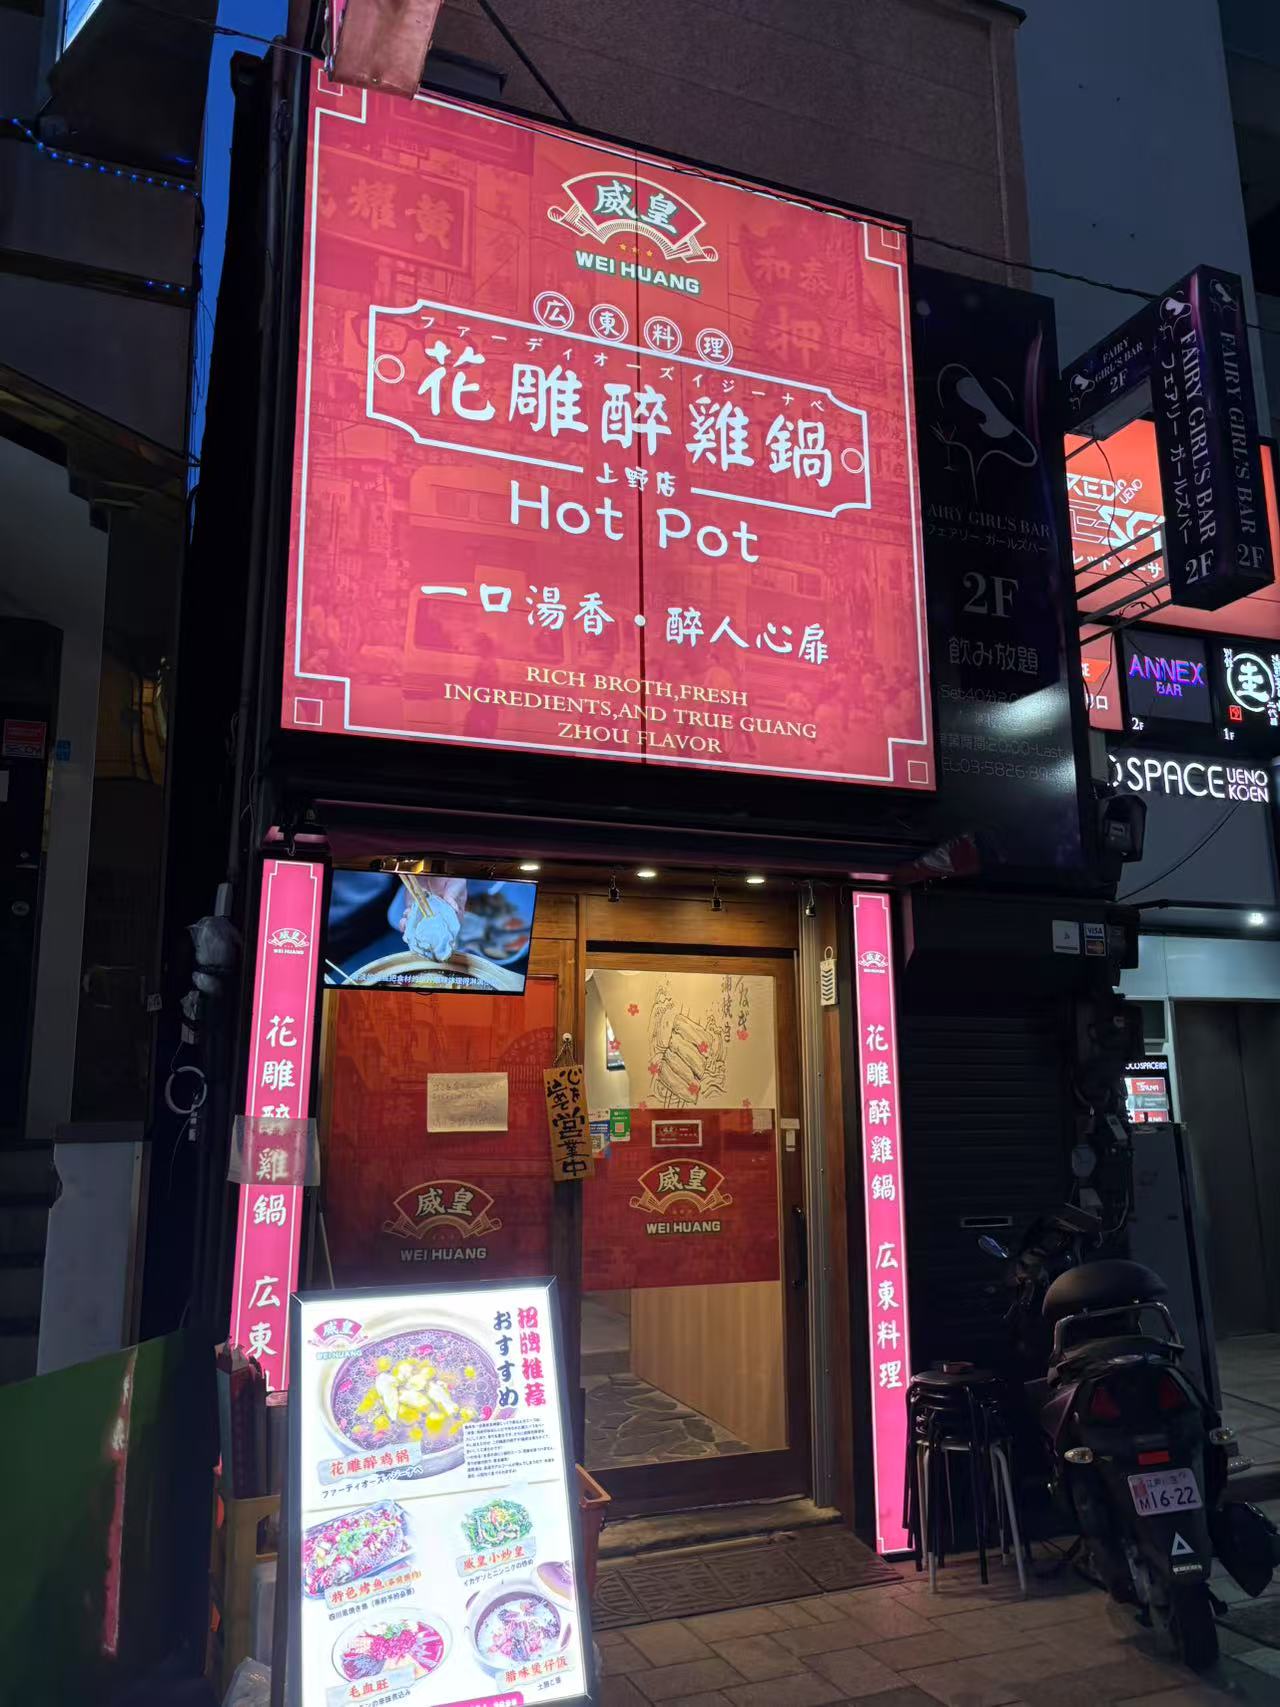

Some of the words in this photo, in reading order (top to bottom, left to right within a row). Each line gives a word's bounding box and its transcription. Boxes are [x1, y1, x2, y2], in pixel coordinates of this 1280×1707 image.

[594, 179, 679, 236] 威皇
[575, 249, 617, 275] WEI
[621, 257, 701, 296] HUANG
[1103, 337, 1129, 363] FAIRY
[1181, 329, 1203, 401] FAIRY
[1219, 331, 1243, 401] FAIRY
[1110, 368, 1128, 393] 2F
[1188, 407, 1212, 486] GIRL'S
[1228, 407, 1250, 480] GIRL'S
[596, 462, 678, 497] 上野店
[1119, 479, 1144, 504] UENO
[510, 480, 624, 542] Hot
[658, 507, 760, 564] Pot
[928, 504, 964, 521] AIRY
[1020, 520, 1050, 538] BAR
[1197, 488, 1217, 544] BAR
[1236, 487, 1257, 536] BAR
[1186, 549, 1216, 584] 2F
[1237, 544, 1264, 568] 2F
[962, 572, 1018, 618] 2F
[948, 635, 1040, 677] 飲み放題
[1128, 653, 1205, 685] ANNEX
[526, 666, 588, 690] RICH
[1155, 680, 1184, 698] BAR
[557, 720, 631, 747] ZHOU
[637, 729, 724, 757] FLAVOR
[673, 707, 734, 732] TRUE
[740, 714, 819, 741] GUANG
[1131, 717, 1145, 731] 2F
[1223, 728, 1235, 741] 1F
[1225, 767, 1268, 787] UENO
[1228, 785, 1270, 804] KOEN
[1086, 927, 1103, 935] VISA
[657, 1165, 708, 1194] 威皇
[416, 1187, 474, 1218] 威皇
[646, 1222, 671, 1235] WEI
[673, 1220, 721, 1234] HUANG
[400, 1249, 429, 1261] WEI
[432, 1247, 487, 1261] HUANG
[875, 1241, 904, 1390] 広東料理
[493, 1311, 519, 1407] おすすめ
[1151, 1486, 1197, 1509] 16-22
